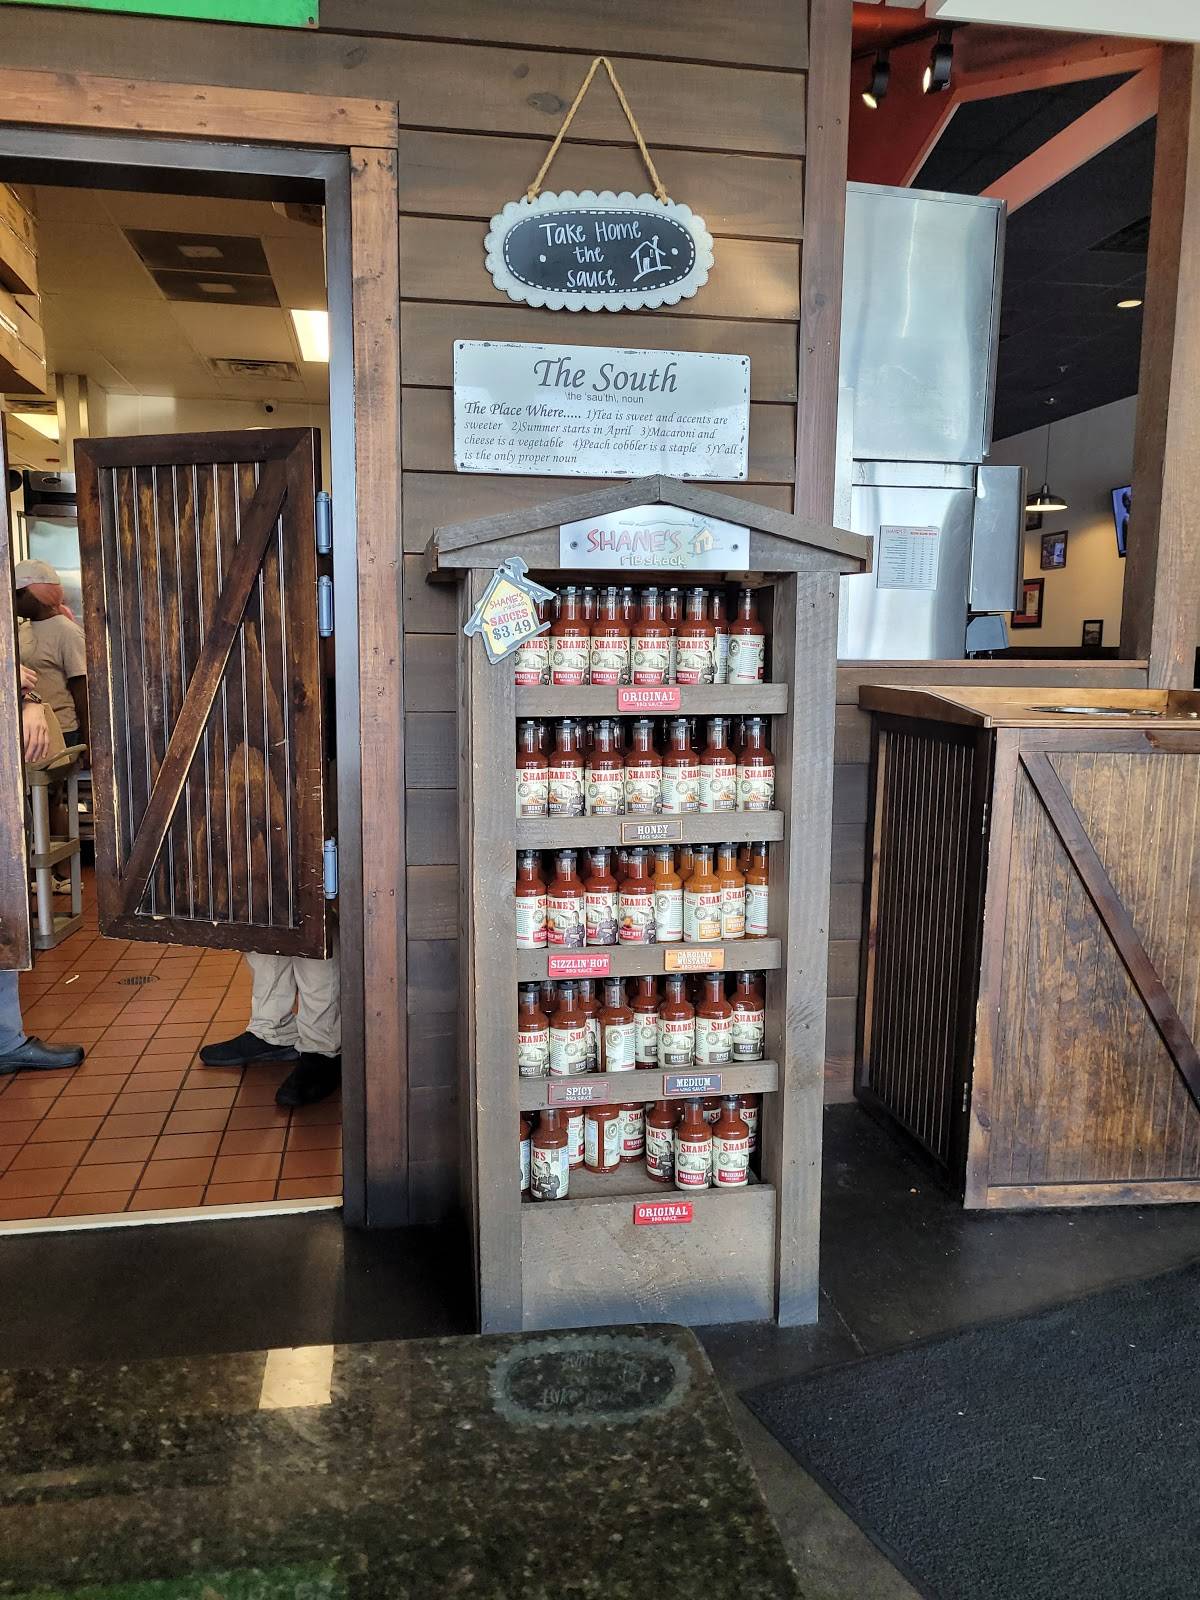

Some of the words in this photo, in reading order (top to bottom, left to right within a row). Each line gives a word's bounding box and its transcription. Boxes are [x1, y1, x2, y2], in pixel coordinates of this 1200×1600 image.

[538, 222, 587, 247] Take
[594, 220, 642, 243] Home
[572, 245, 605, 264] the
[533, 356, 586, 388] The
[592, 361, 678, 393] South
[621, 395, 644, 404] noun
[464, 400, 487, 415] The
[489, 402, 522, 416] Place
[615, 410, 623, 421] is
[626, 412, 653, 422] sweet
[656, 411, 677, 423] and
[676, 415, 711, 425] accents
[713, 416, 728, 425] are
[464, 421, 504, 431] sweeter
[562, 424, 591, 434] starts
[593, 424, 603, 435] in
[604, 424, 634, 439] April
[697, 429, 718, 440] and
[464, 434, 495, 445] cheese
[497, 435, 506, 446] is
[508, 438, 515, 446] a
[517, 436, 564, 450] vegetable
[612, 439, 649, 451] cobbler
[649, 443, 658, 452] is
[669, 444, 697, 456] staple
[464, 449, 473, 460] is
[475, 448, 492, 460] the
[494, 450, 517, 464] only
[518, 453, 551, 465] proper
[552, 453, 578, 464] noun
[586, 528, 682, 553] SHANE'S
[489, 592, 524, 610] SHANE'S
[489, 608, 530, 627] SAUCES
[491, 619, 532, 641] $3.49
[594, 638, 628, 650] SHANE'S
[622, 691, 675, 702] ORIGINAL
[637, 824, 669, 835] HONEY
[550, 959, 590, 969] SIZZLIN'
[590, 958, 609, 968] HOT
[677, 951, 713, 959] CAROLINA
[677, 957, 711, 965] MUSTARD
[566, 1086, 594, 1096] SPICY
[676, 1077, 711, 1088] MEDIUM
[638, 1206, 689, 1218] ORIGINAL
